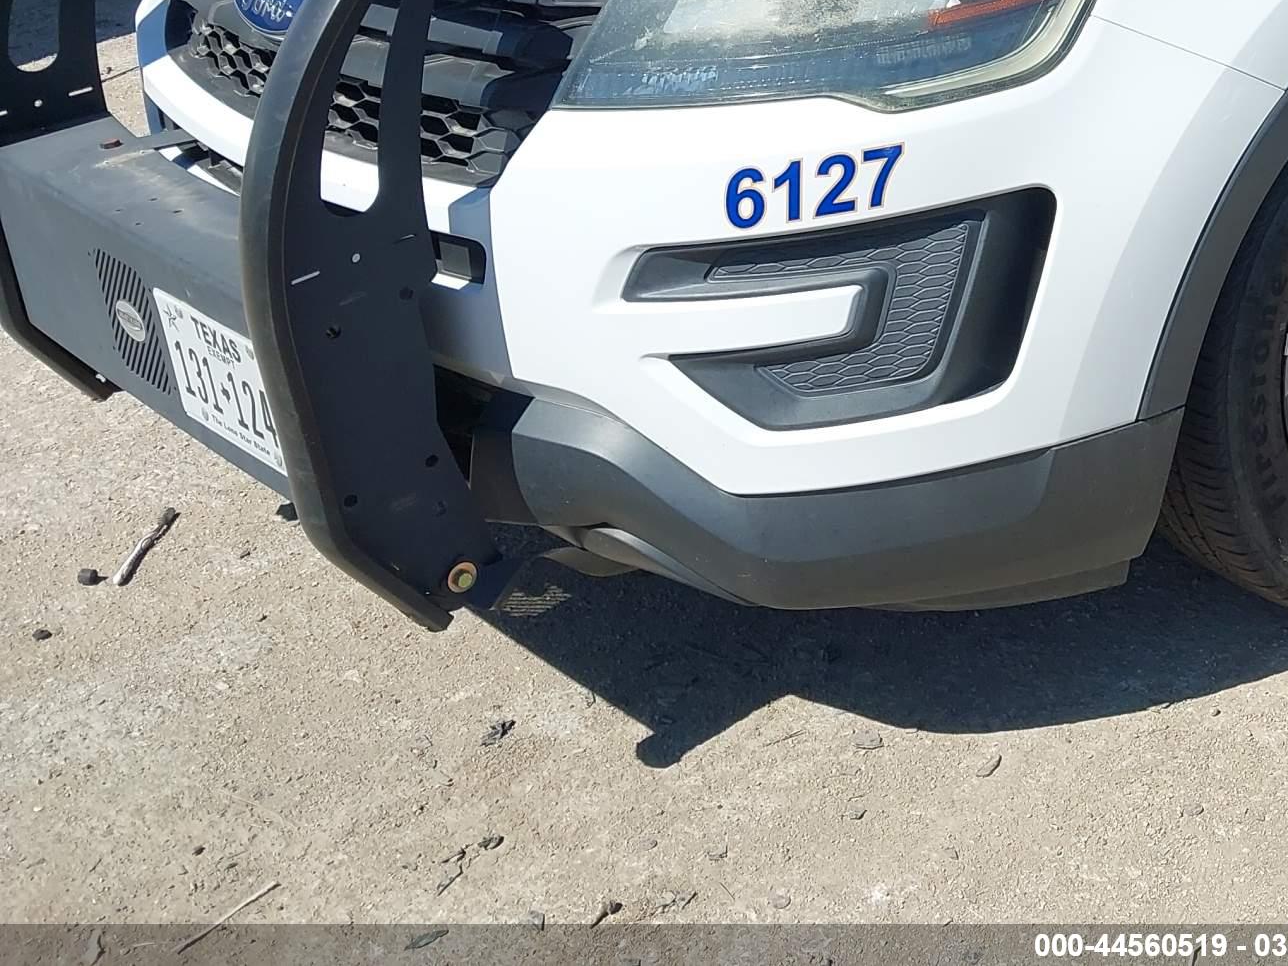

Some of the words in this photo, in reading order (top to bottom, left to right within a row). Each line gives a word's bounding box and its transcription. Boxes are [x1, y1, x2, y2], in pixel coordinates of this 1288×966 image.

[725, 142, 904, 229] 6127
[191, 315, 242, 364] TEXAS
[207, 346, 236, 370] EXEMPT
